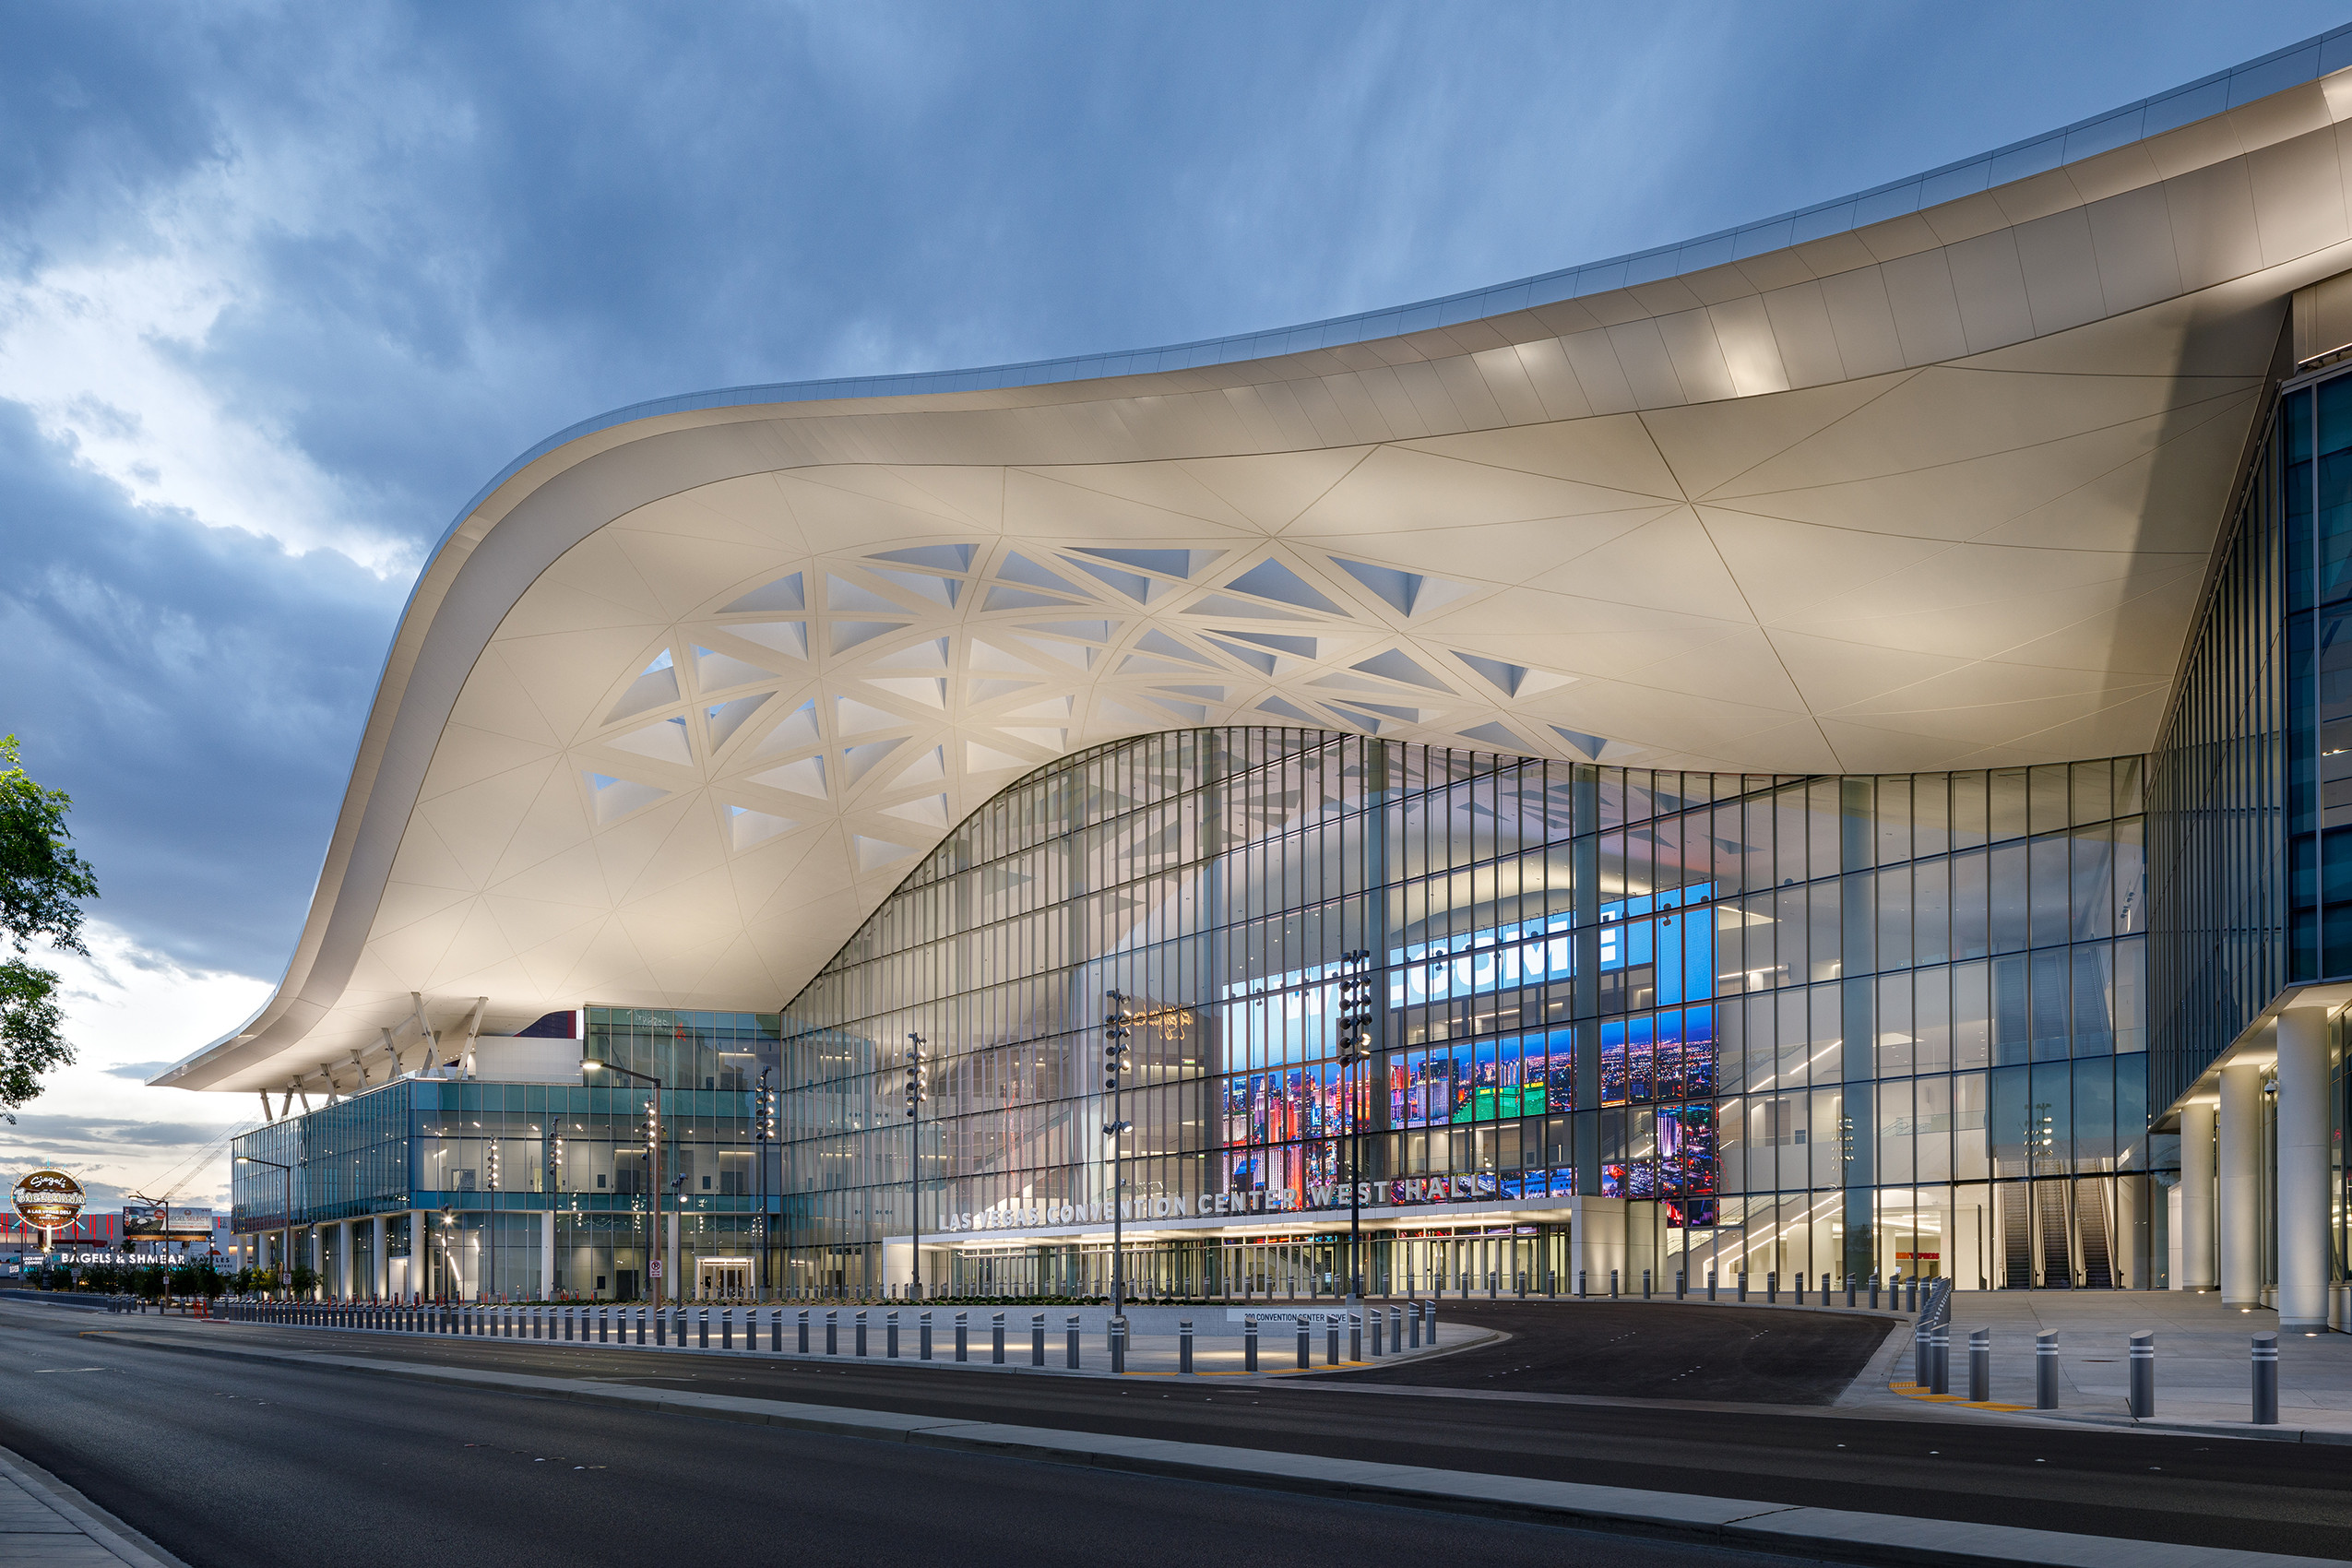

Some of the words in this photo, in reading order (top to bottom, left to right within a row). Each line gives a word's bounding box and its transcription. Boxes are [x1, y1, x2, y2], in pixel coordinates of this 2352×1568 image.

[30, 1176, 66, 1188] Siegel's
[17, 1191, 86, 1205] BAGELMANIA
[939, 1213, 971, 1230] LAS
[979, 1207, 1039, 1228] VEGAS
[1047, 1196, 1186, 1224] CONVENTION
[1197, 1187, 1298, 1214] CENTER
[1311, 1181, 1391, 1206] WEST
[1405, 1174, 1487, 1200] HALL
[61, 1253, 112, 1264] BAGELS
[115, 1254, 125, 1264] &
[129, 1253, 185, 1265] SHMEAR
[1256, 1313, 1297, 1322] CONVENTION
